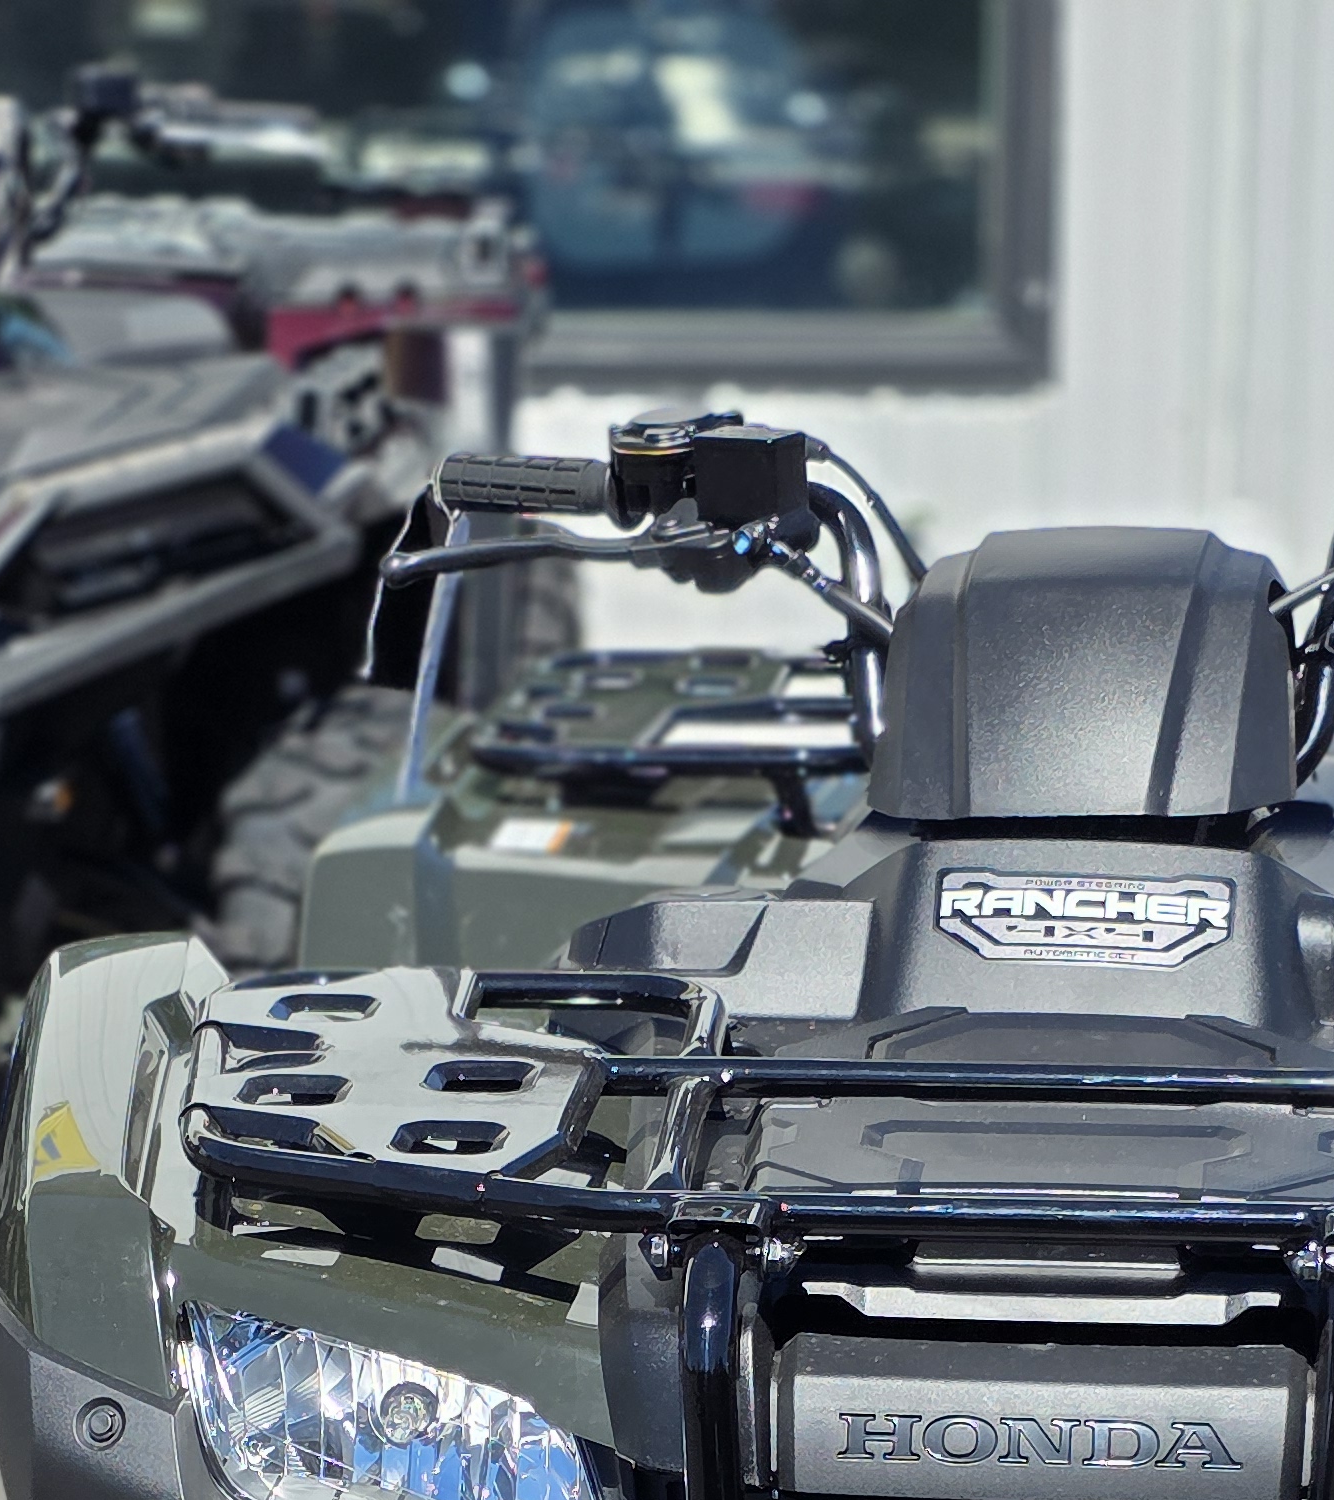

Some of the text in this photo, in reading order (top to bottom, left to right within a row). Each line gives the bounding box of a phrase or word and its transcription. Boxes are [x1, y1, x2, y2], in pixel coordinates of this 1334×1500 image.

[940, 888, 1231, 927] RANCHER
[1023, 948, 1106, 958] AUTOMATIC
[836, 1412, 1244, 1471] HONDA
